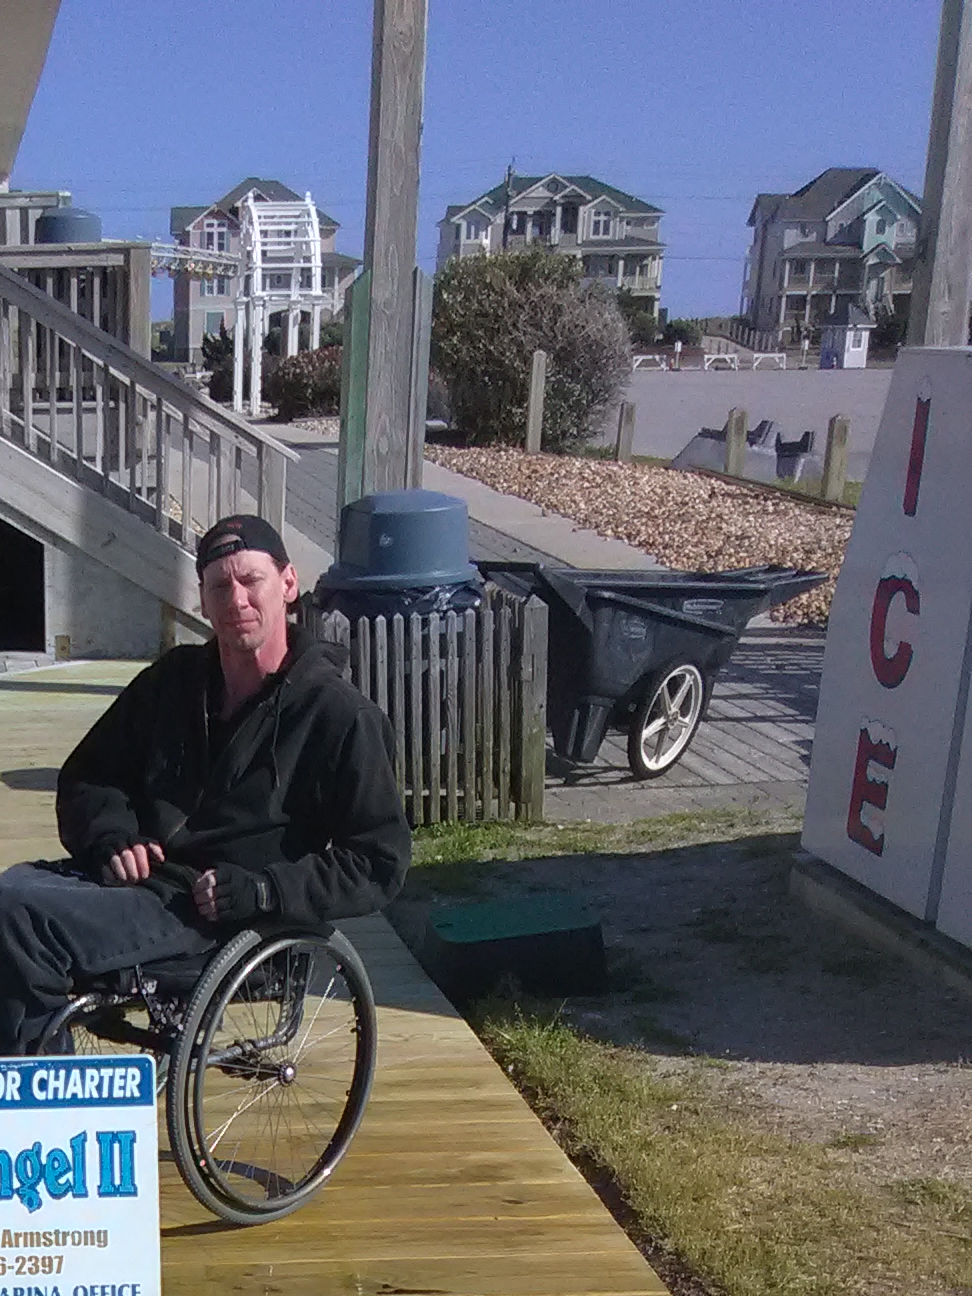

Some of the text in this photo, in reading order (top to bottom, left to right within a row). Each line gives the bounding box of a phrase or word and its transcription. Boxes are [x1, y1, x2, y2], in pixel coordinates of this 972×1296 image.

[847, 374, 932, 856] ICE
[32, 1068, 141, 1098] CHARTER
[96, 1131, 137, 1198] II
[1, 1229, 108, 1248] Armstrong
